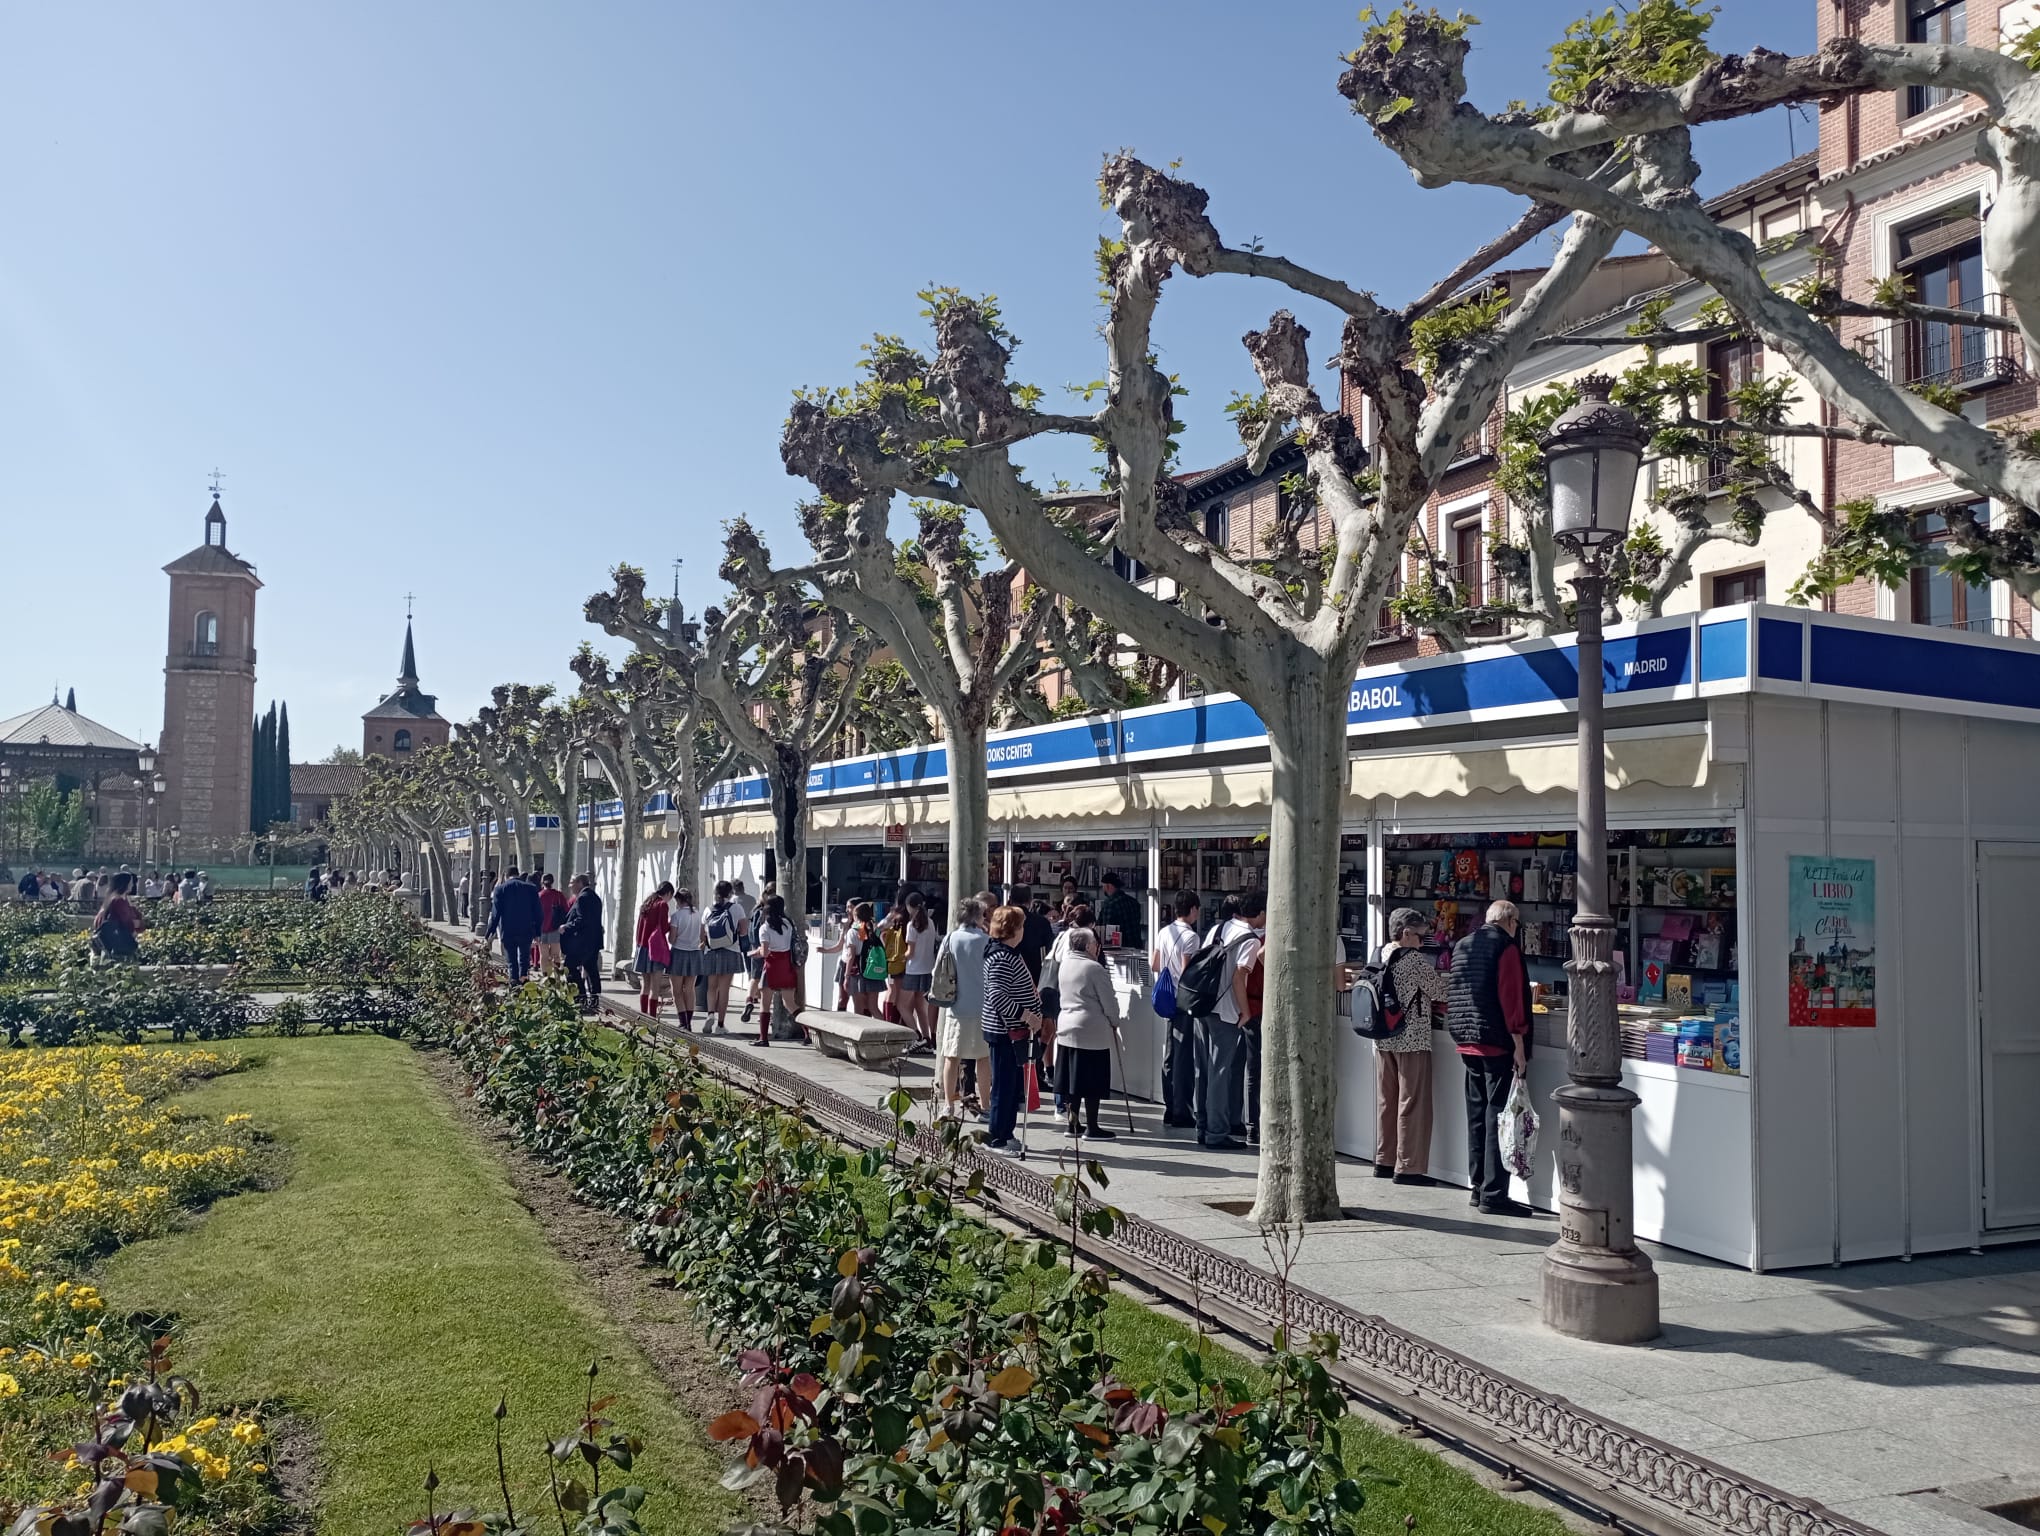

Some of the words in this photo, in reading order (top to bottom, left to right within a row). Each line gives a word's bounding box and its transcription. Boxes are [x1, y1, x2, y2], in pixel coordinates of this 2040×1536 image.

[1624, 657, 1668, 676] MADRID
[1005, 742, 1033, 761] CENTER
[1850, 868, 1865, 881] del
[1812, 882, 1853, 898] LIBRO
